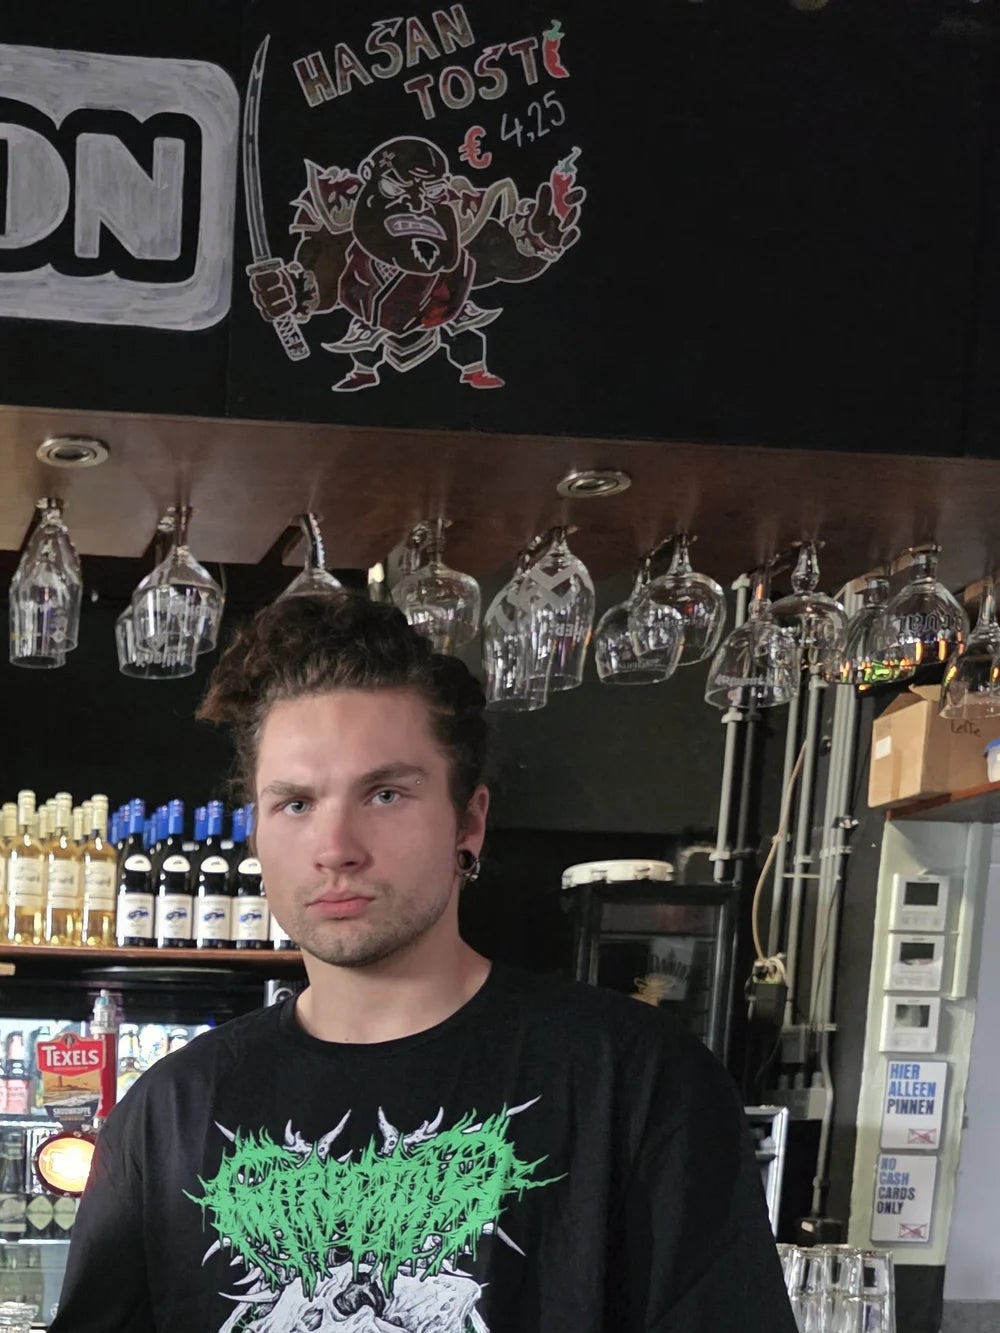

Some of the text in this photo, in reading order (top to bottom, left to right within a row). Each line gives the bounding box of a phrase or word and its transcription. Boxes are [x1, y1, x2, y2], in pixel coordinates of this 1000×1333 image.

[293, 4, 475, 107] HASAN
[889, 1063, 921, 1080] HIER
[888, 1081, 937, 1098] ALLEEN
[886, 1099, 935, 1115] PINNEN
[880, 1157, 897, 1171] NO
[878, 1172, 910, 1186] CASH
[877, 1186, 916, 1201] CARDS
[876, 1200, 904, 1215] ONLY
